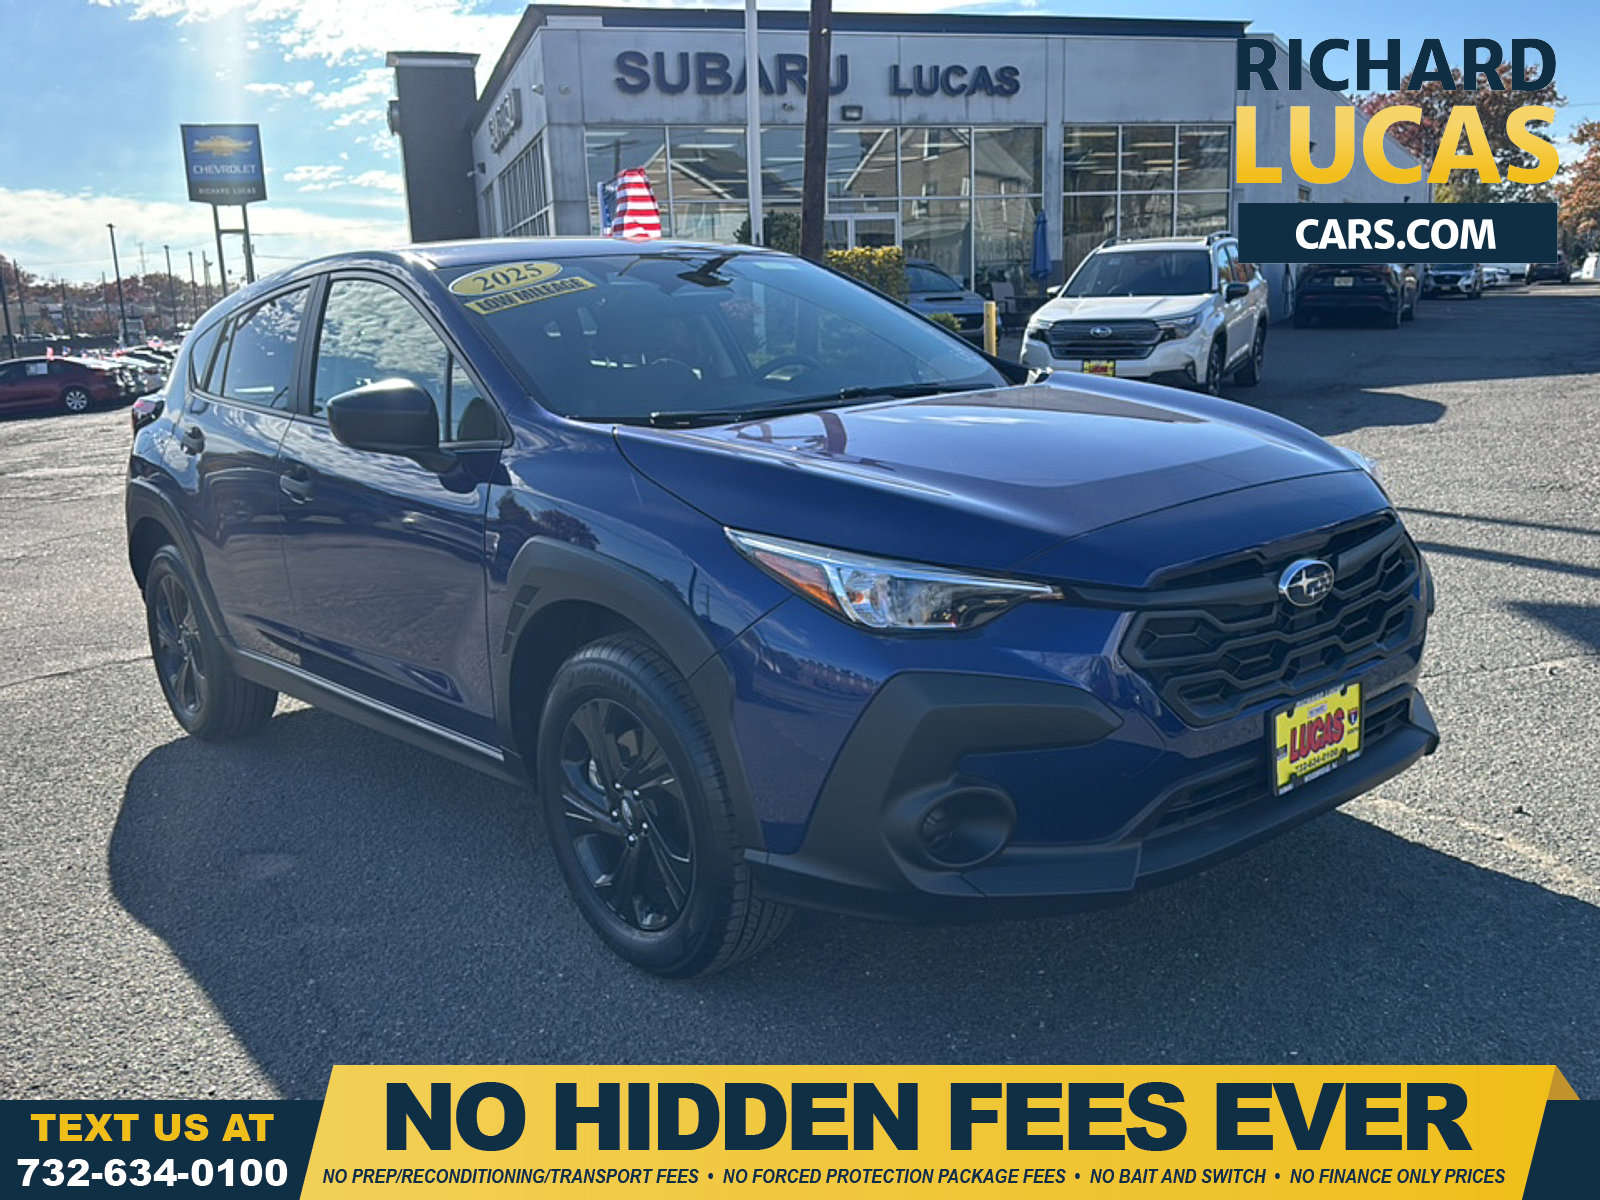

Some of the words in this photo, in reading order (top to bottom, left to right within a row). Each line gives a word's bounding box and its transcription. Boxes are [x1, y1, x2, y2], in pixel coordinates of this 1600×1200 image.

[614, 51, 848, 96] SUBARU
[889, 64, 1020, 97] LUCAS
[193, 164, 256, 175] CHEVROLET
[473, 263, 543, 292] 2025
[475, 293, 516, 312] LOW
[516, 278, 585, 301] MILEAGE
[1289, 708, 1345, 764] LUCAS
